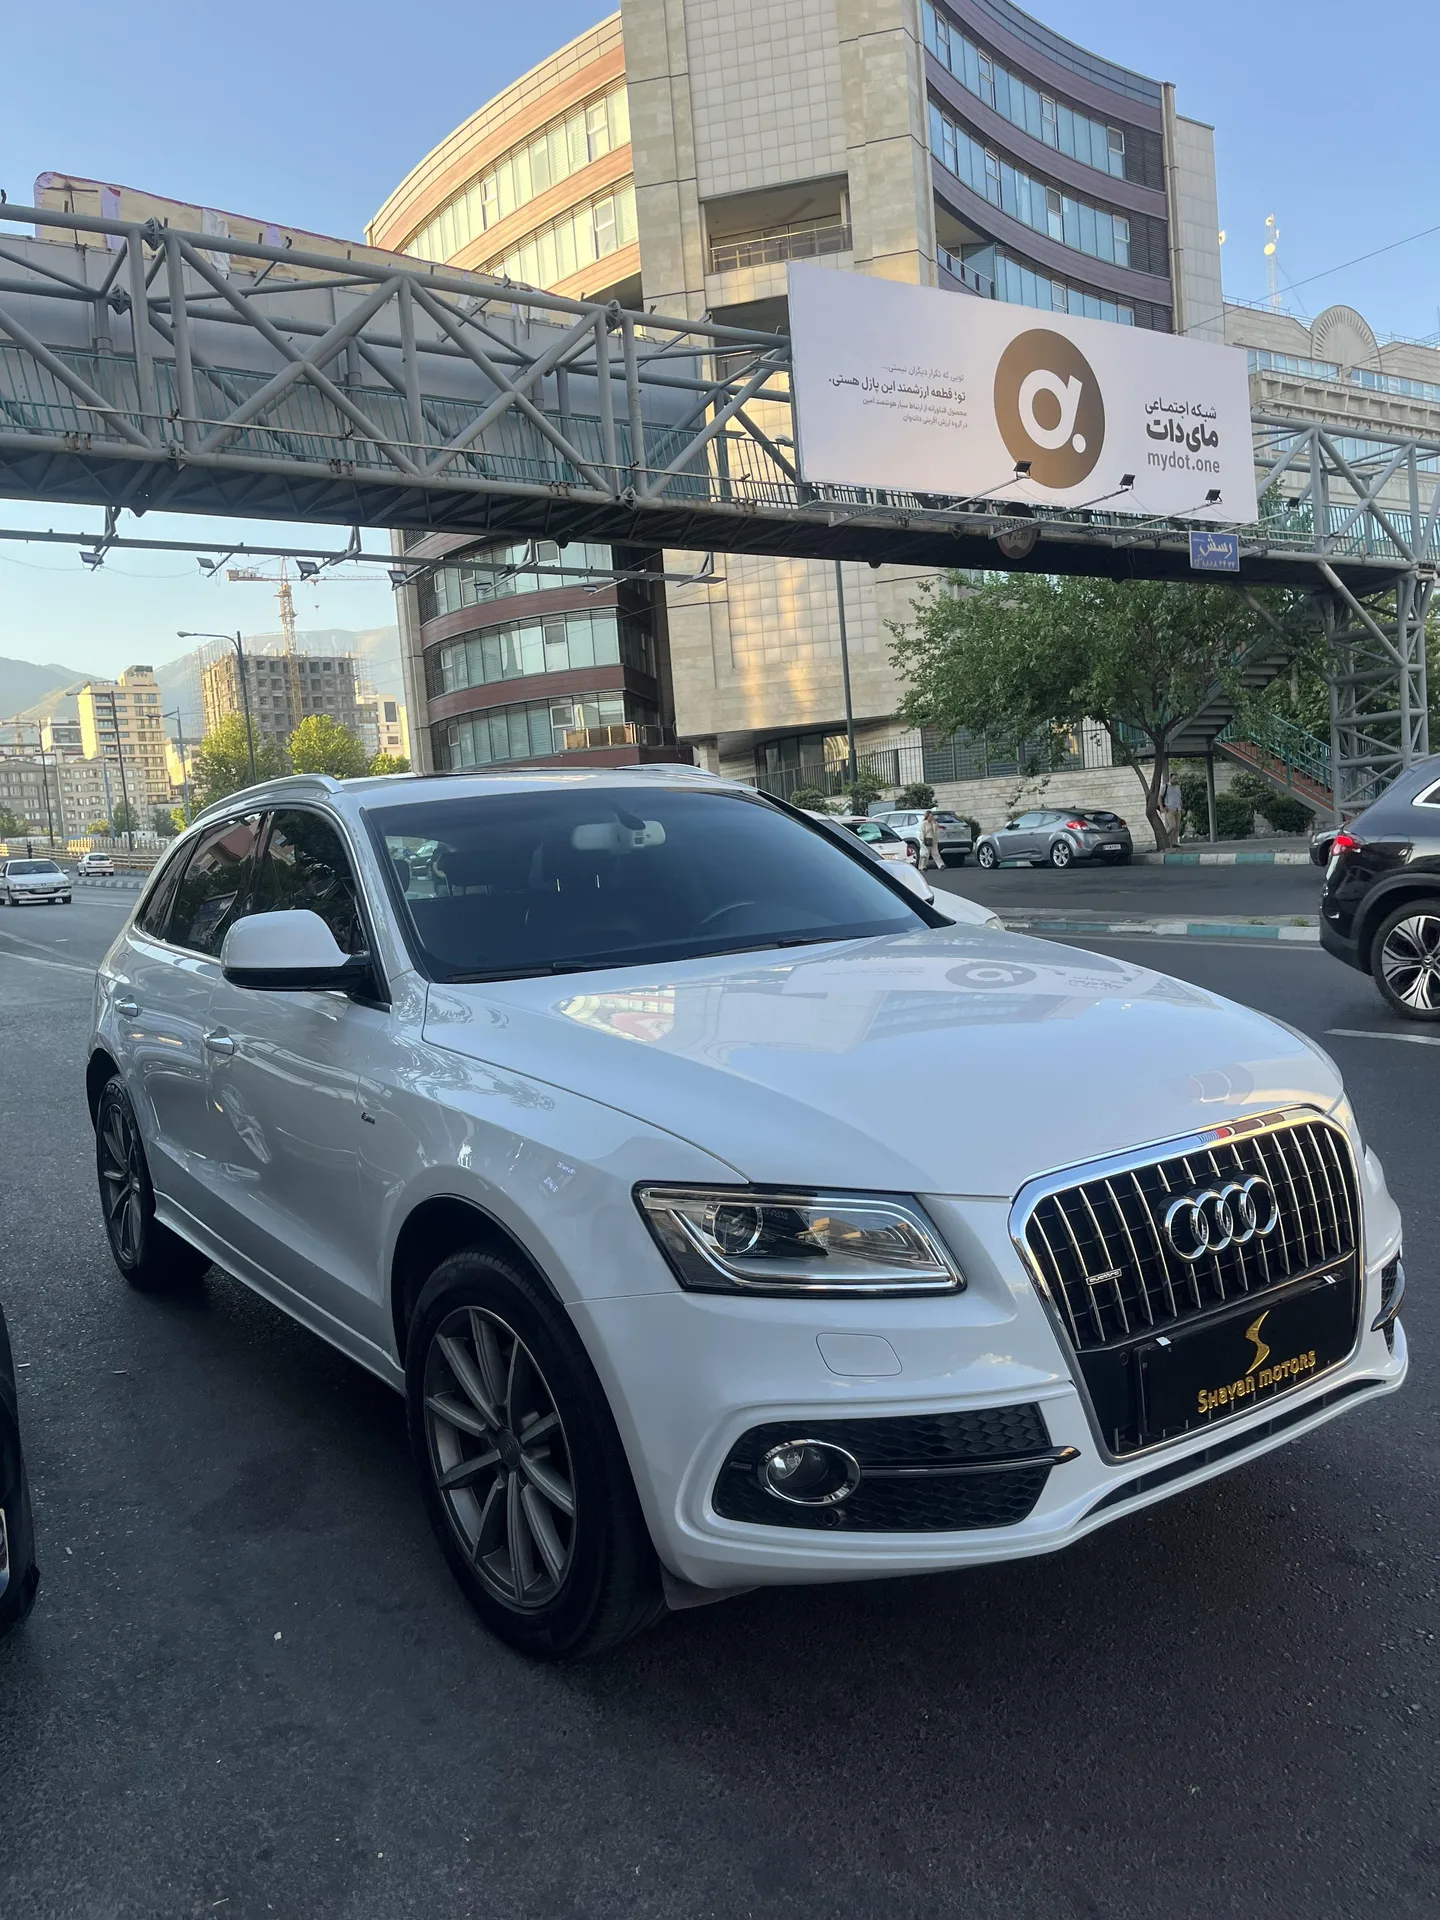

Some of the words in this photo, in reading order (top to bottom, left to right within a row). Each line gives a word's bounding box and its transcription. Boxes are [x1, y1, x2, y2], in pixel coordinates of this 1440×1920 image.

[909, 366, 928, 376] دیگران
[928, 369, 941, 380] تکرار
[862, 376, 879, 393] پازل
[881, 381, 896, 394] این
[898, 383, 929, 398] ارزشمند
[931, 388, 952, 399] قطعه
[1145, 397, 1189, 419] اجتماعی
[1191, 404, 1217, 423] شبکه
[1147, 450, 1221, 474] mydot.one
